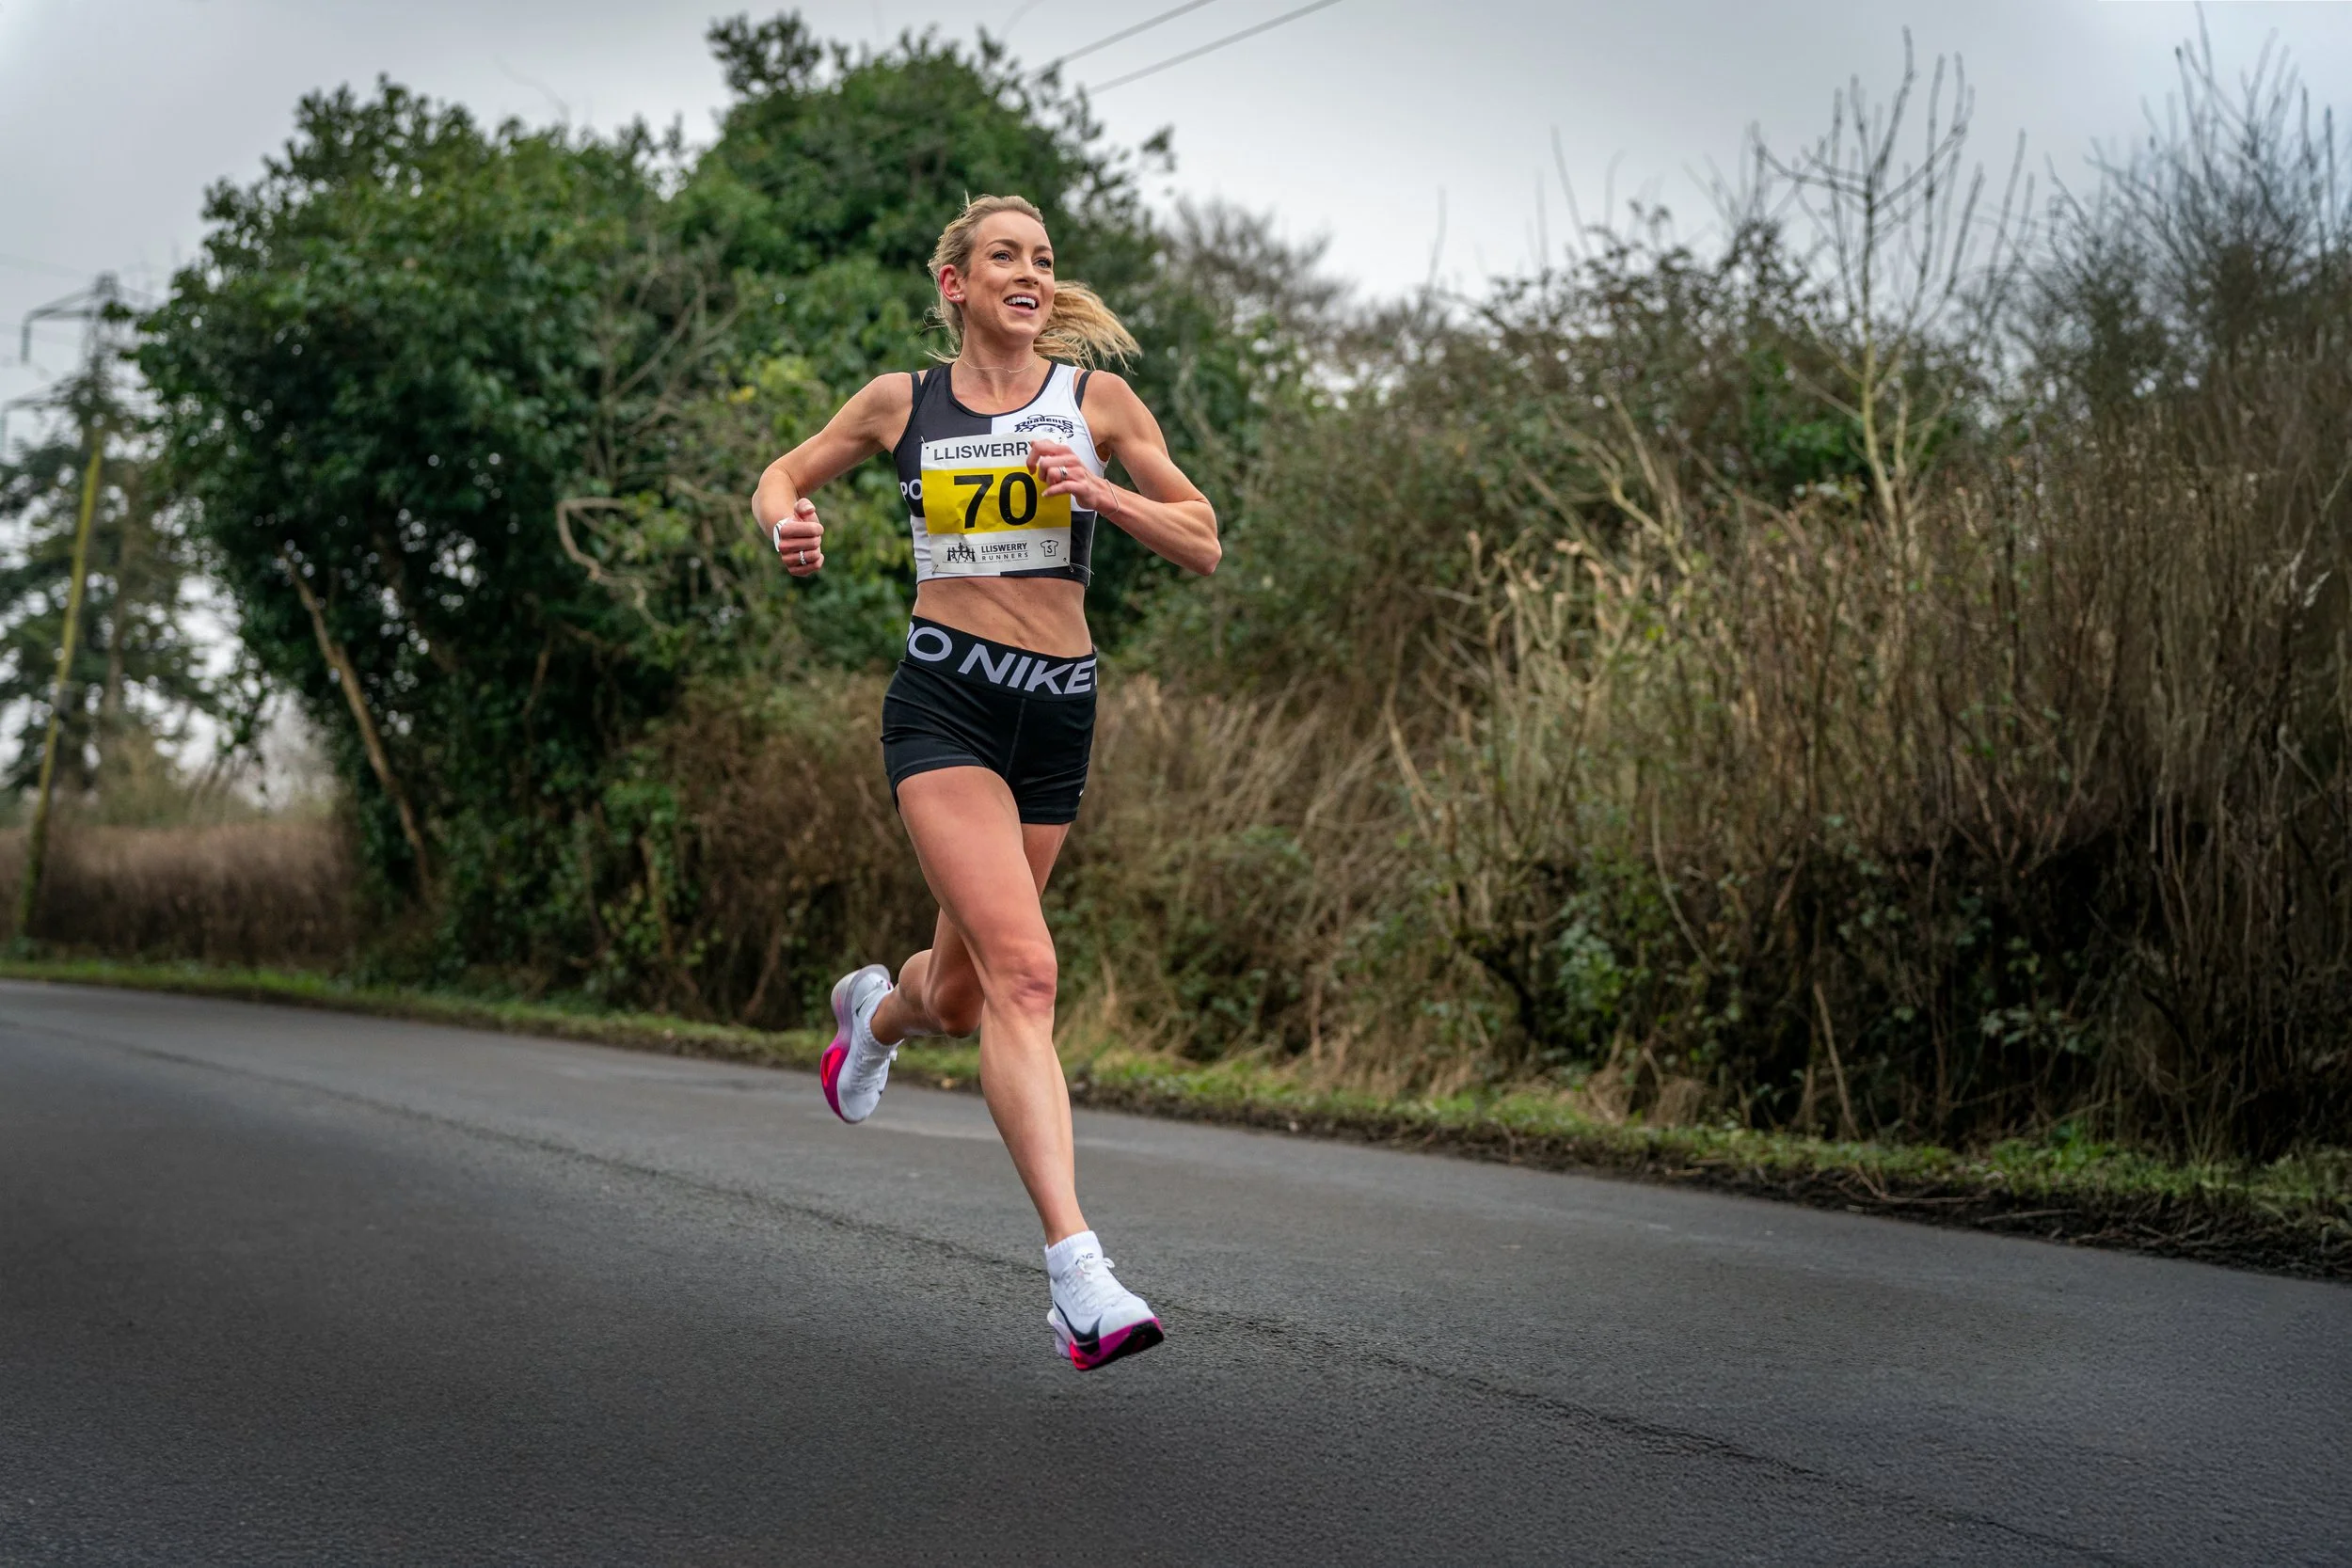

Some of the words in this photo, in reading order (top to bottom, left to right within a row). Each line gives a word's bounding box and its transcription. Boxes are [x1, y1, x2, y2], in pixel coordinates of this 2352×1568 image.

[934, 441, 1031, 461] LLISWERR
[953, 471, 1038, 530] 70
[981, 542, 1027, 553] LLISWERRY
[1046, 545, 1053, 554] S
[981, 552, 1028, 562] RUNNERS
[958, 642, 1097, 695] NIKE
